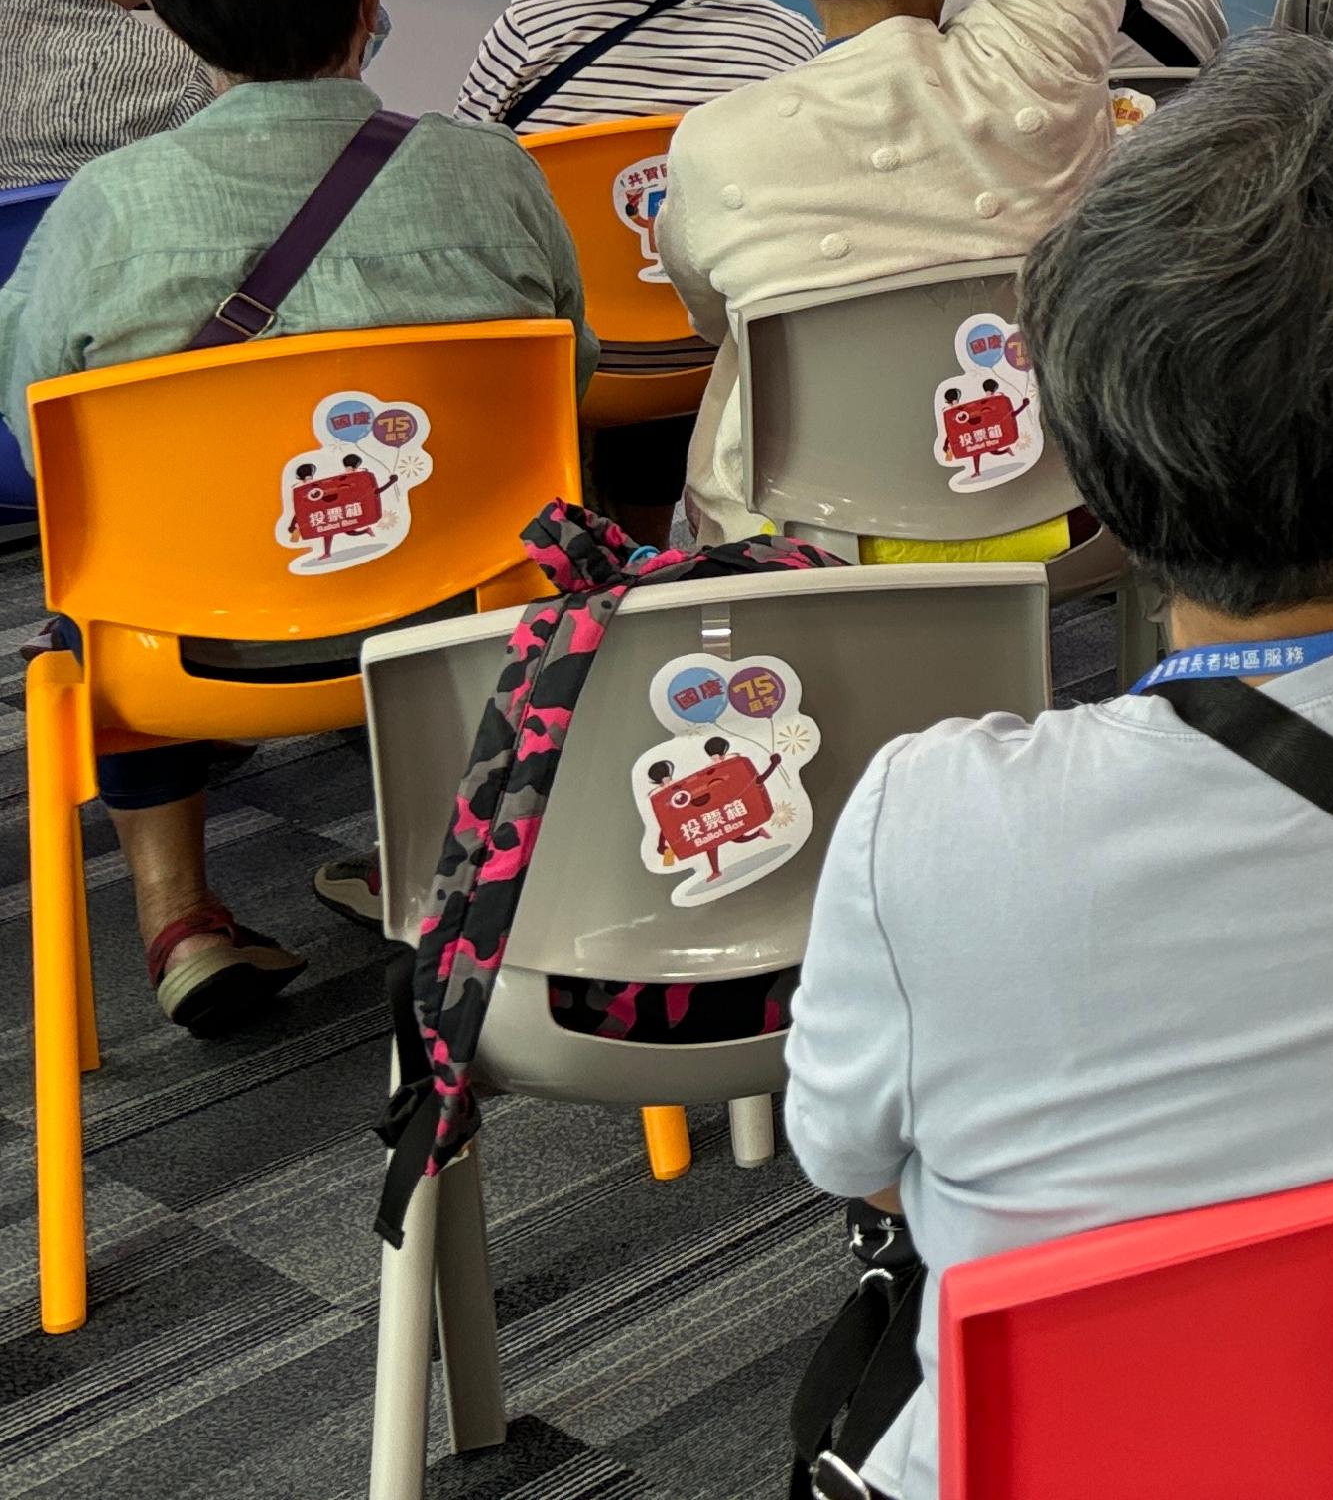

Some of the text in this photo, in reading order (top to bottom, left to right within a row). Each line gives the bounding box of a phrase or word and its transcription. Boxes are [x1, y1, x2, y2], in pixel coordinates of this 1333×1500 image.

[377, 417, 410, 433] 75
[959, 424, 1002, 447] 投票箱
[310, 502, 363, 527] 投票箱
[732, 675, 776, 700] 75
[680, 799, 748, 841] 投票箱
[694, 819, 745, 847] Ballot Box
